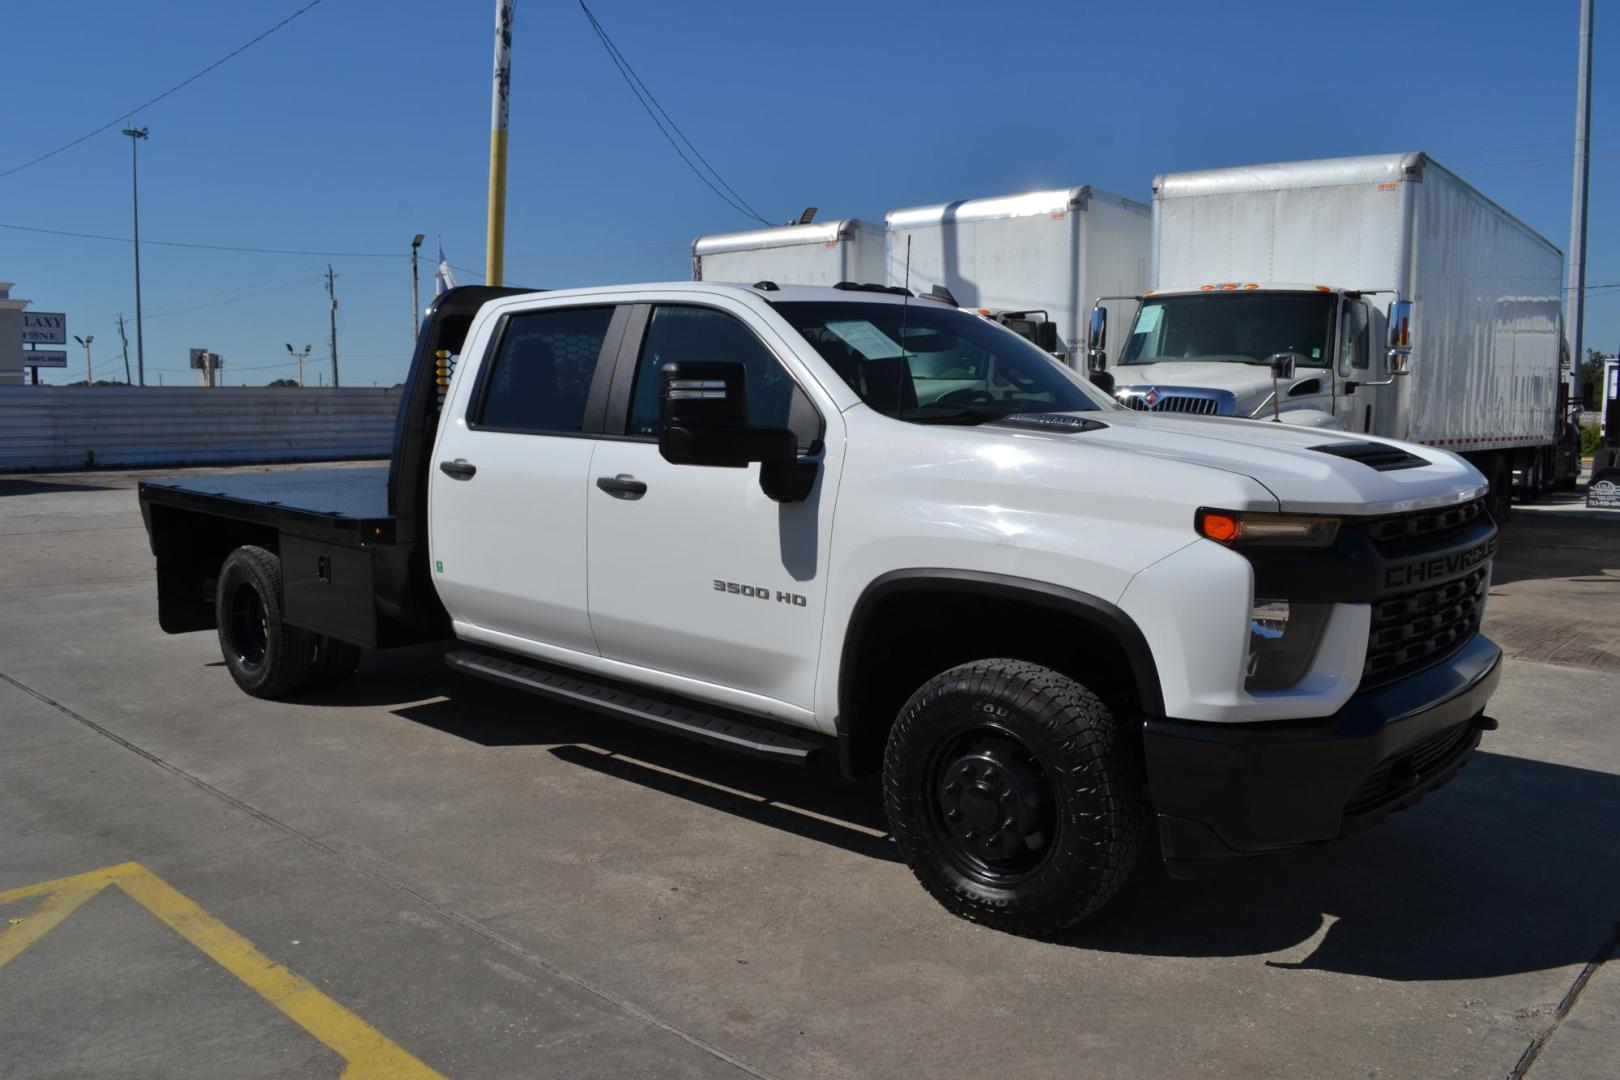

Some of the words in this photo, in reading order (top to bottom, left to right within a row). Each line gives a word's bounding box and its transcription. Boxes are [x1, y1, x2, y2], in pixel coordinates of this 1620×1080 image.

[24, 315, 63, 328] LAXY
[22, 331, 59, 340] TONE
[1384, 536, 1498, 589] CHEVROLE
[713, 579, 770, 600] 3500
[776, 590, 807, 607] HD
